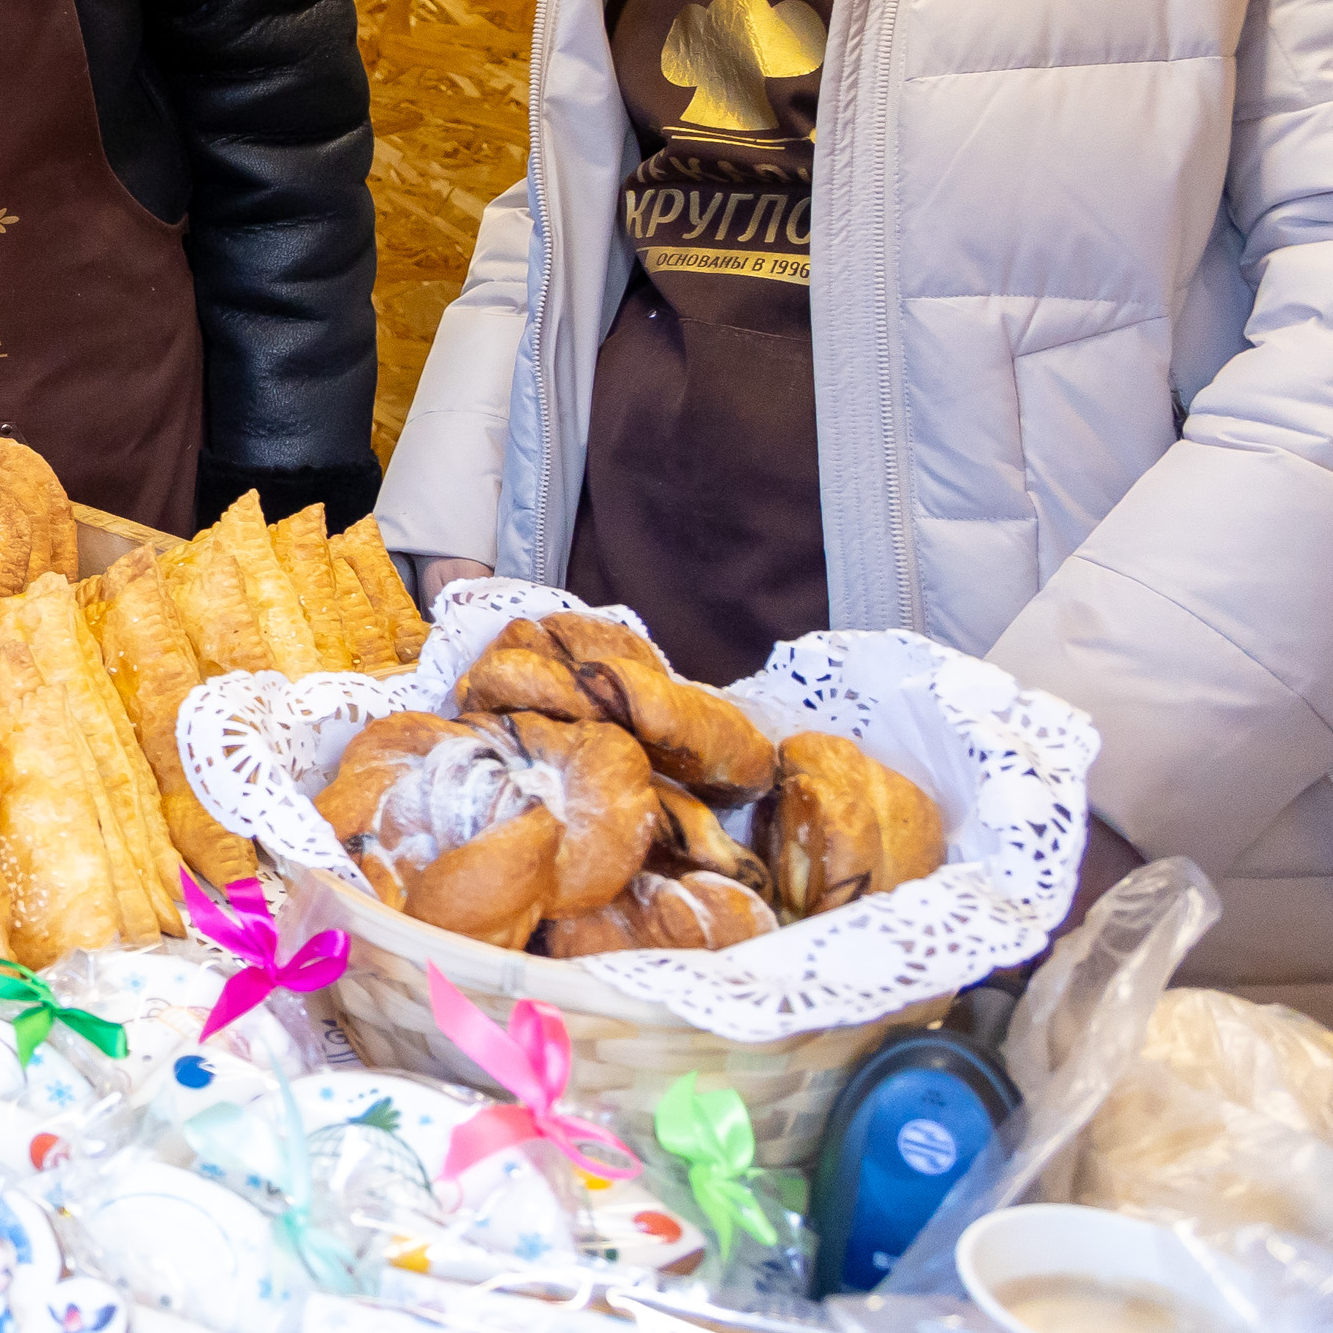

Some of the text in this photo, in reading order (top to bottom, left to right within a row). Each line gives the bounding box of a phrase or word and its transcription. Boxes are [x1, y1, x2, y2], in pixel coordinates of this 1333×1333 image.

[656, 253, 810, 278] ОСНОВАНЫ В 1996
